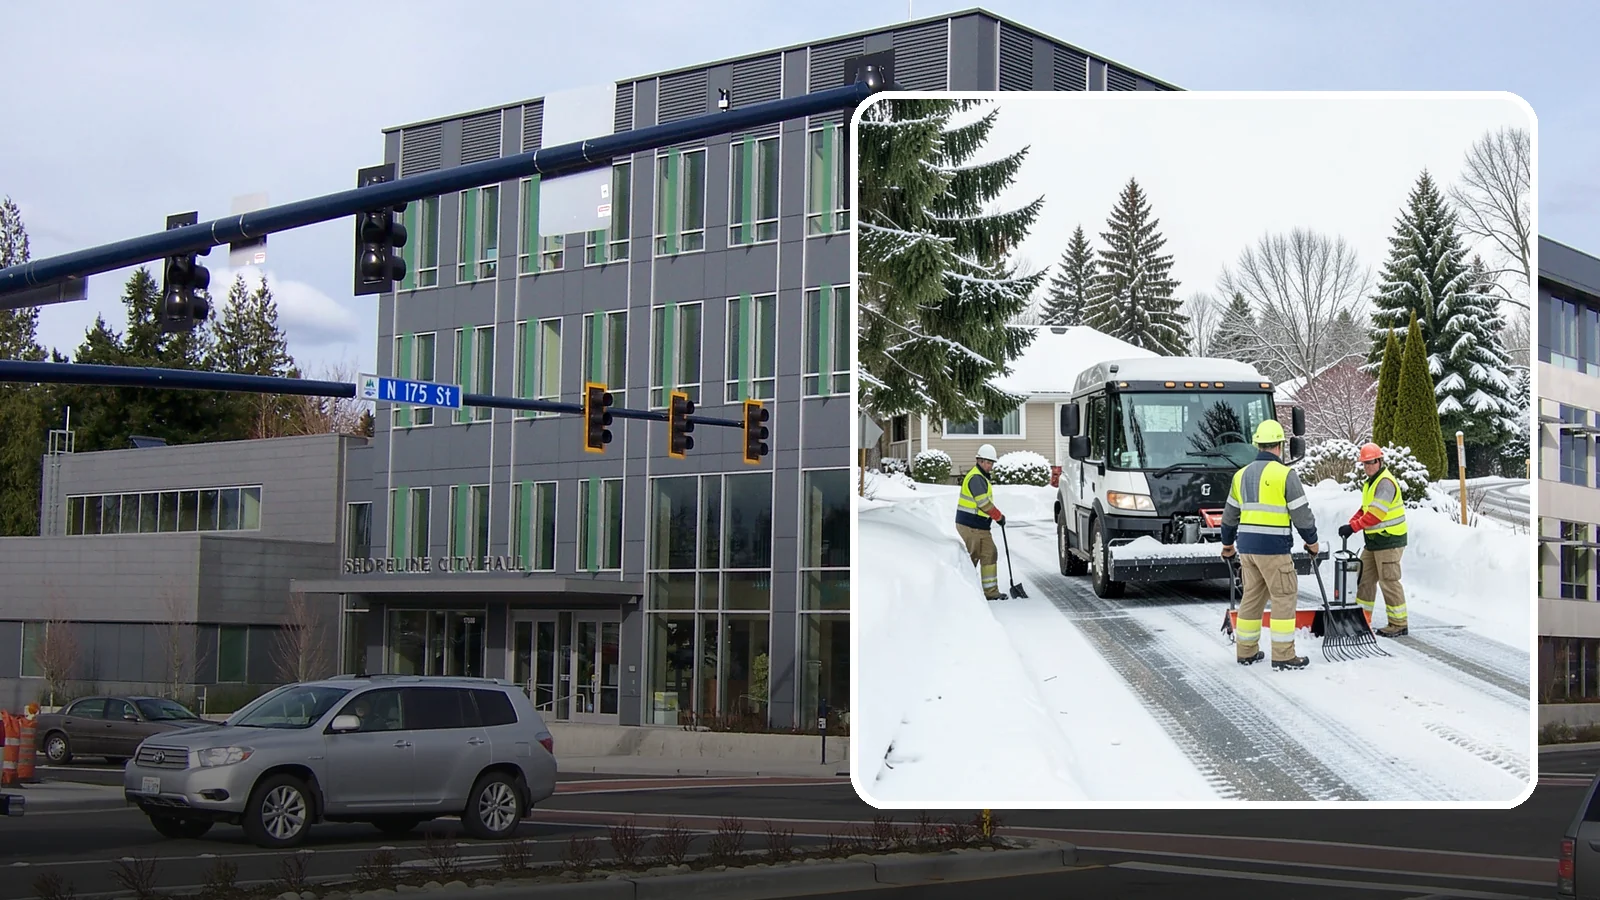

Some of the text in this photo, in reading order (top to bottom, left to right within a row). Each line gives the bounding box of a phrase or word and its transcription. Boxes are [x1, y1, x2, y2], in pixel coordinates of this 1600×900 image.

[387, 380, 451, 406] N 175 St
[343, 555, 525, 574] SHORELINE CITY HALL
